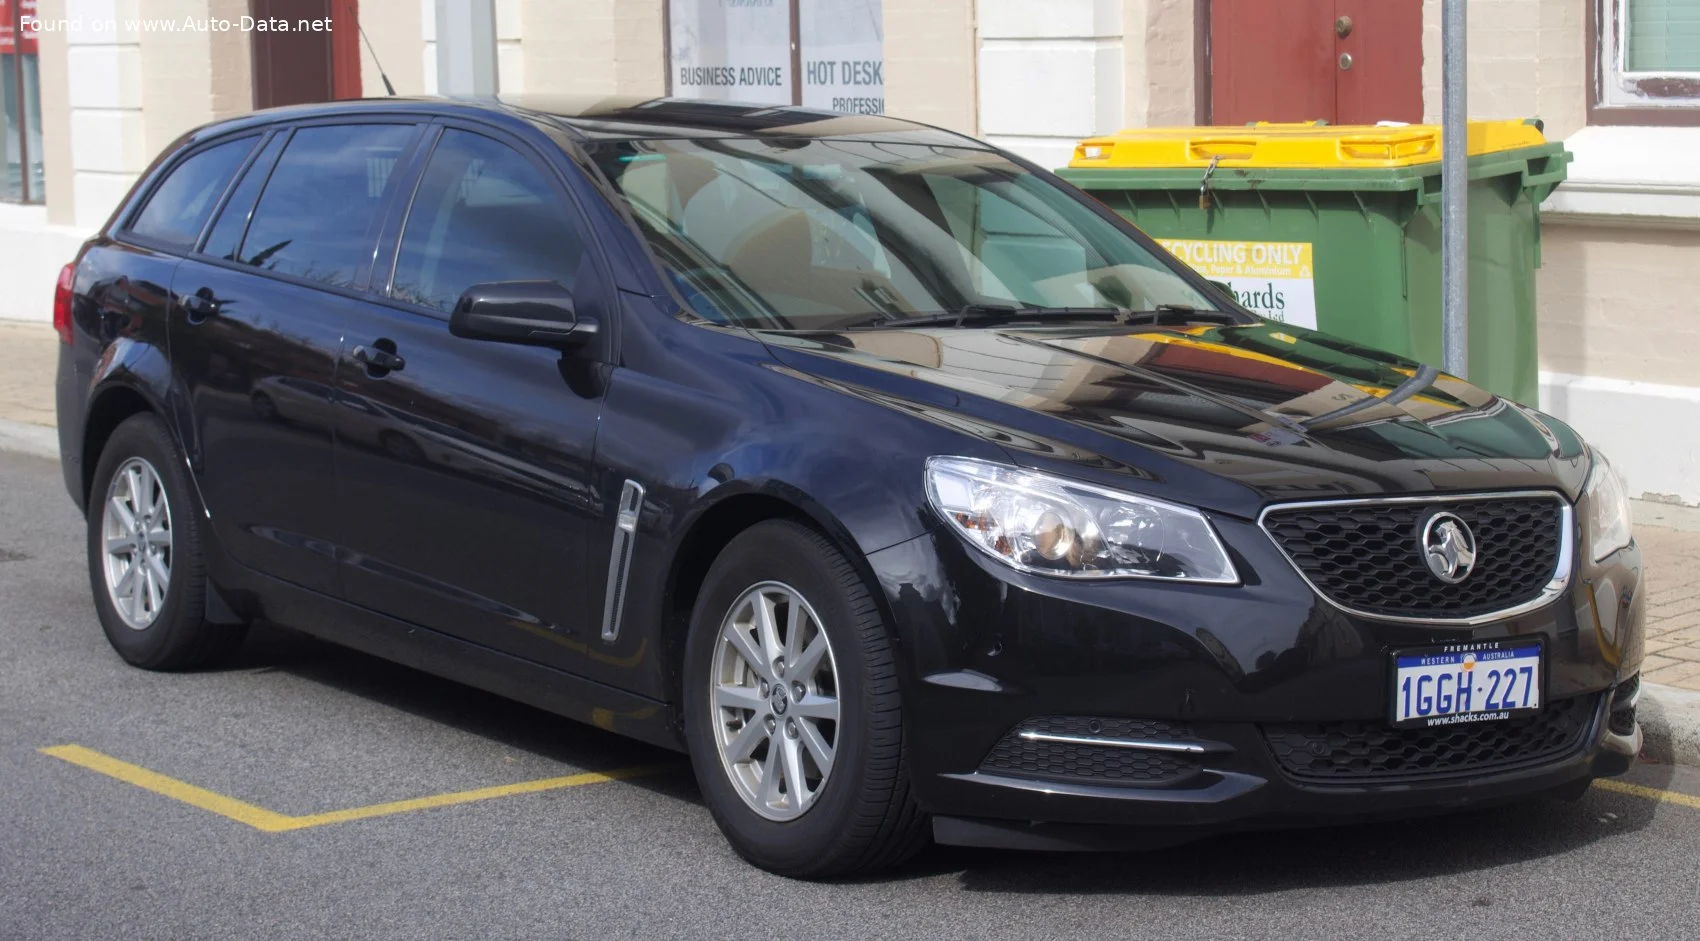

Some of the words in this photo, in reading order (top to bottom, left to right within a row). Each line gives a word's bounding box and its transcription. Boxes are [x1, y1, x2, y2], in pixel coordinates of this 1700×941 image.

[680, 67, 736, 86] BUSINESS
[739, 67, 782, 86] ADVICE
[807, 61, 836, 85] HOT
[1251, 244, 1303, 265] ONLY
[1443, 641, 1500, 653] FREMANTLE
[1420, 656, 1455, 666] WESTERN
[1482, 650, 1515, 660] AUSTRALIA
[1427, 711, 1510, 727] www.shacks.com.au
